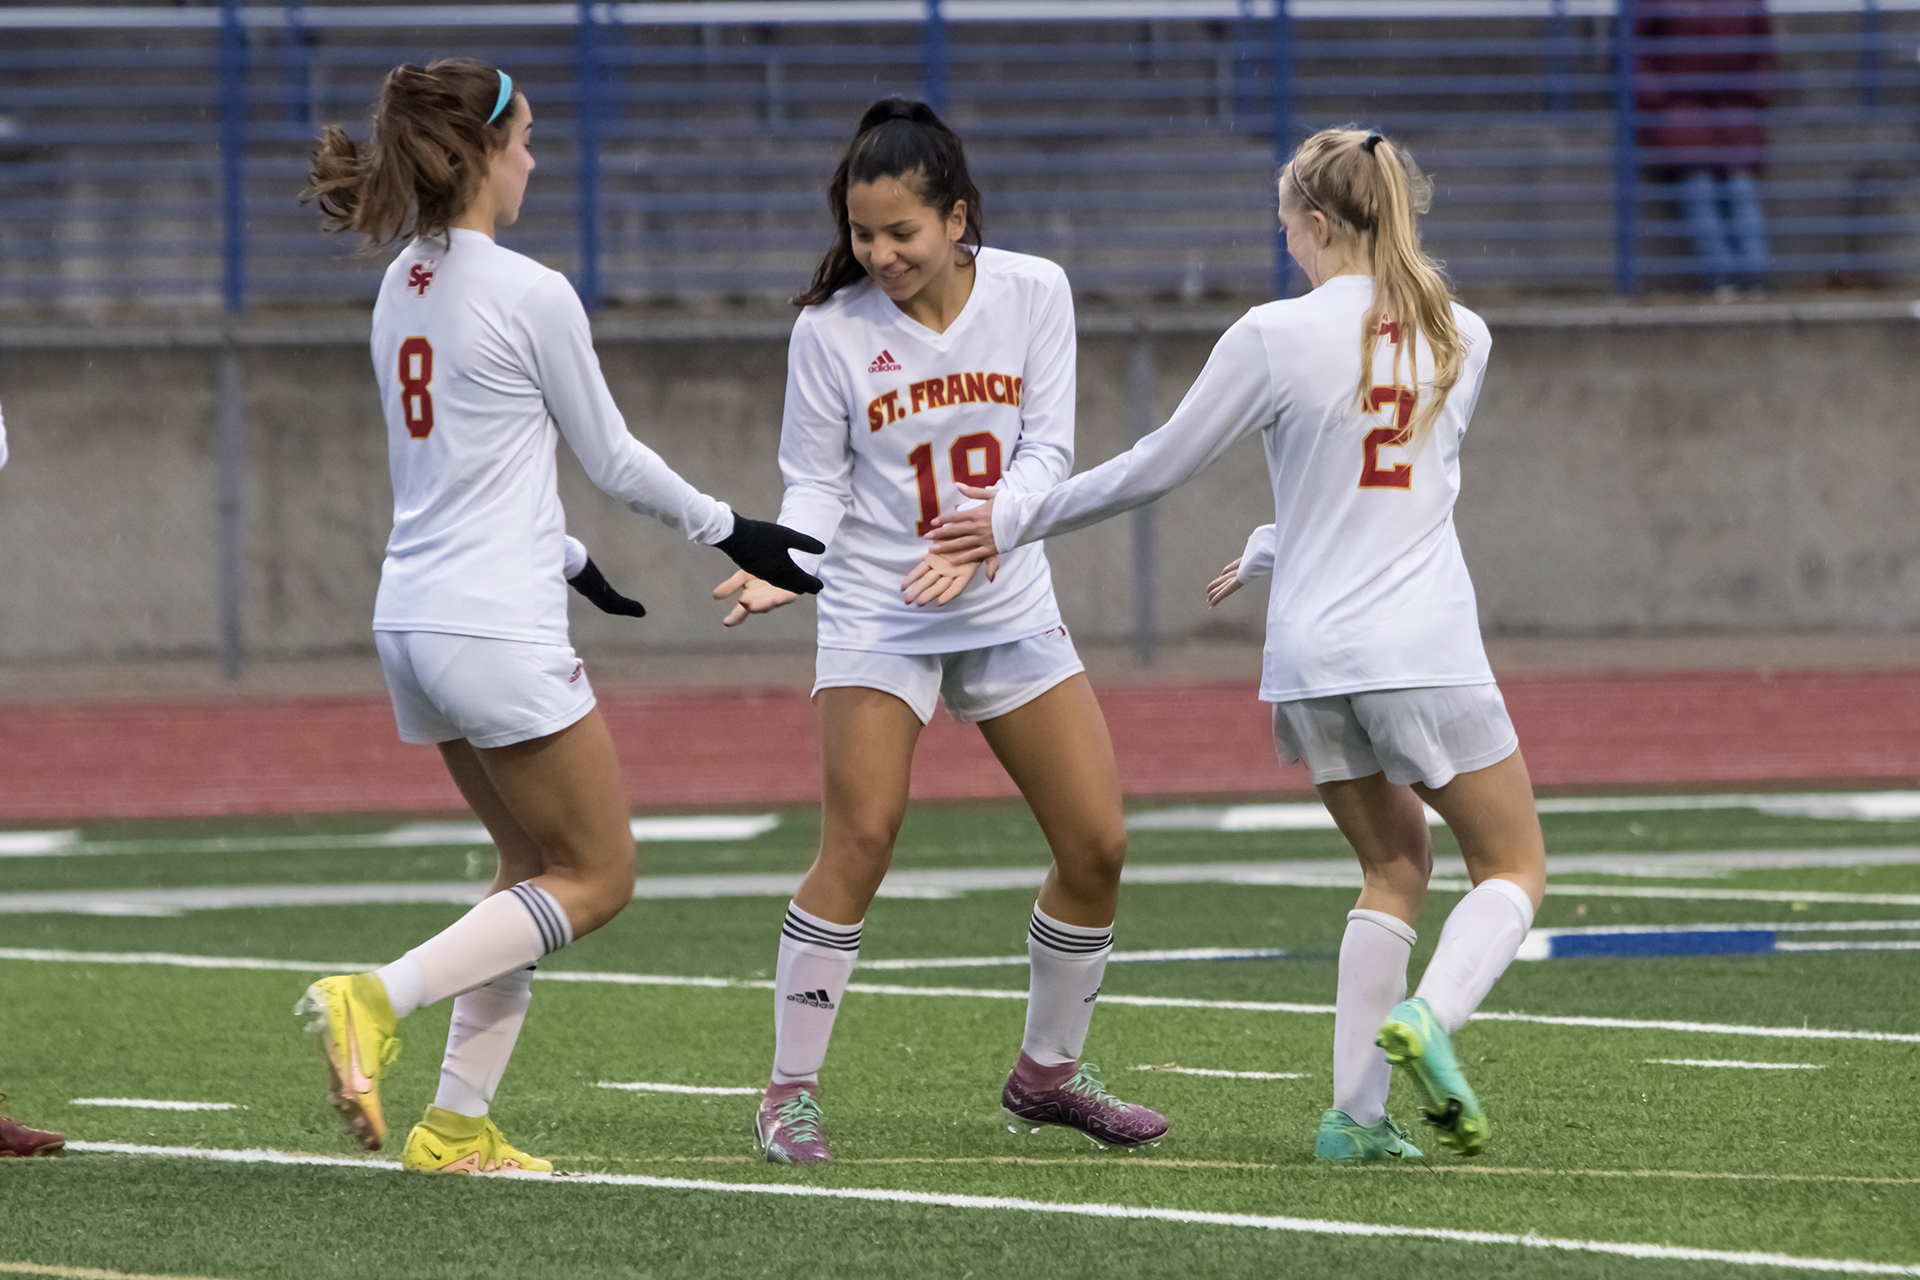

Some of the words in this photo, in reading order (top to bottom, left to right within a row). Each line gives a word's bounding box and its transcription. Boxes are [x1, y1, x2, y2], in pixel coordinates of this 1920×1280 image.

[408, 263, 434, 296] SF
[398, 336, 435, 440] 8
[868, 363, 902, 373] adidas
[867, 388, 907, 434] ST.
[1358, 385, 1416, 490] 2
[907, 430, 1003, 538] 19
[786, 993, 835, 1009] adidas
